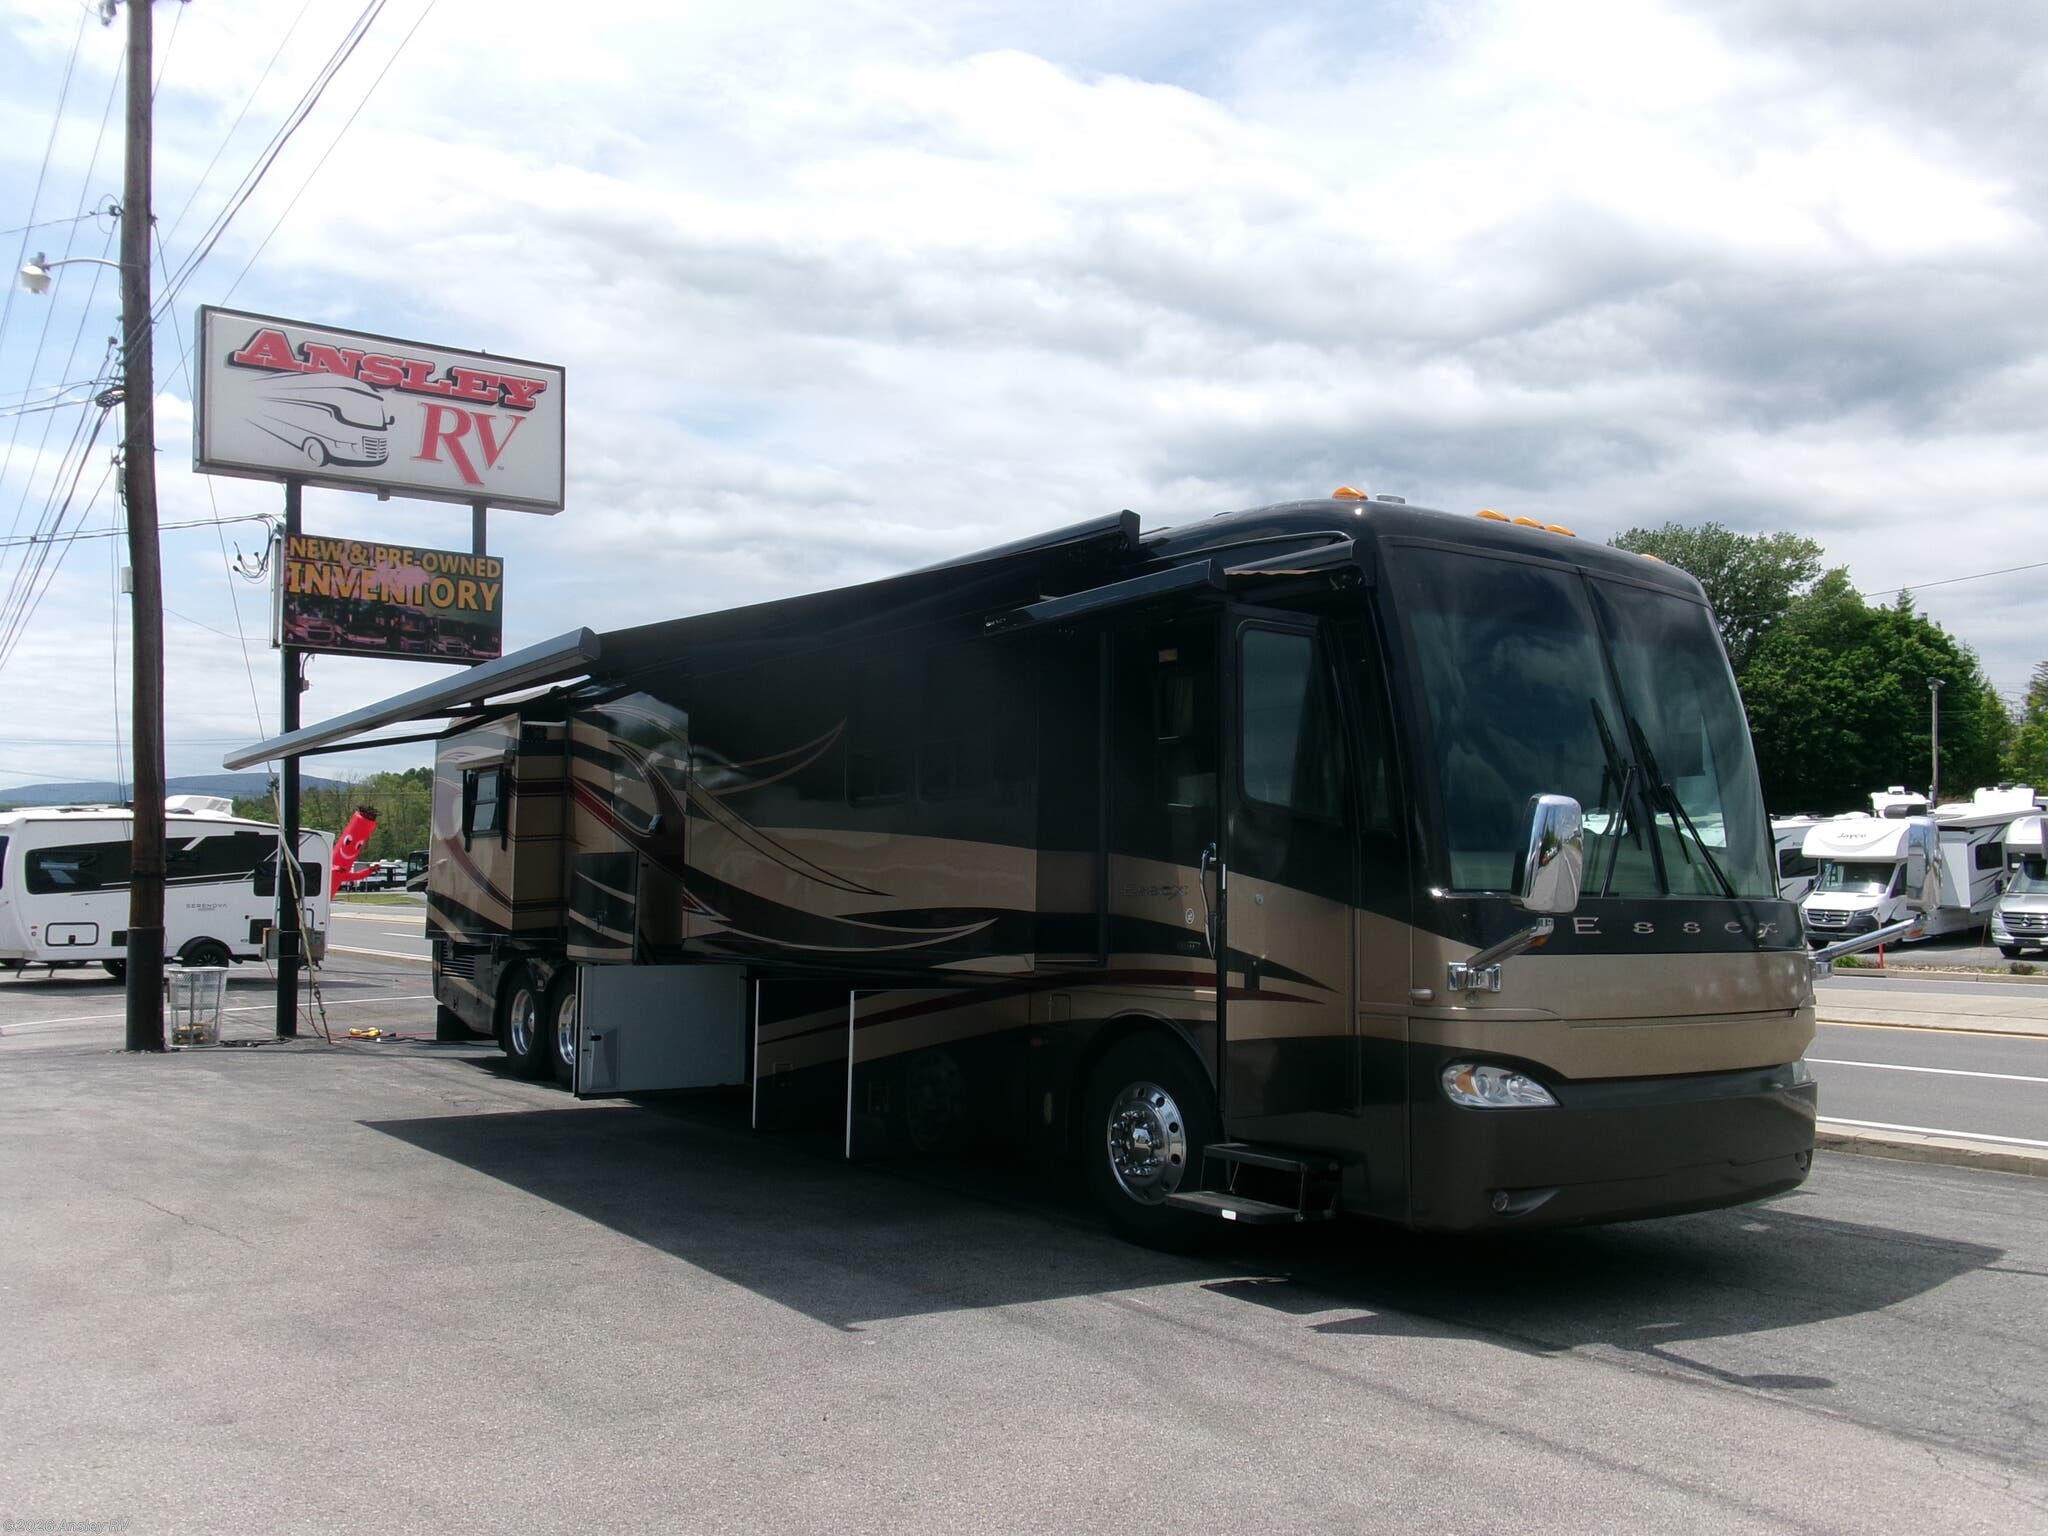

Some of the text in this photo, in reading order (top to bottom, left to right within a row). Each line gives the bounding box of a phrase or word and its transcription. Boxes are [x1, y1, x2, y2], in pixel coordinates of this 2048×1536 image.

[228, 328, 547, 410] ANSLEY
[410, 401, 527, 487] RV
[288, 536, 501, 579] NEW & PRE-OWNED
[288, 561, 500, 611] INVENTORY
[1573, 916, 1779, 939] Essex
